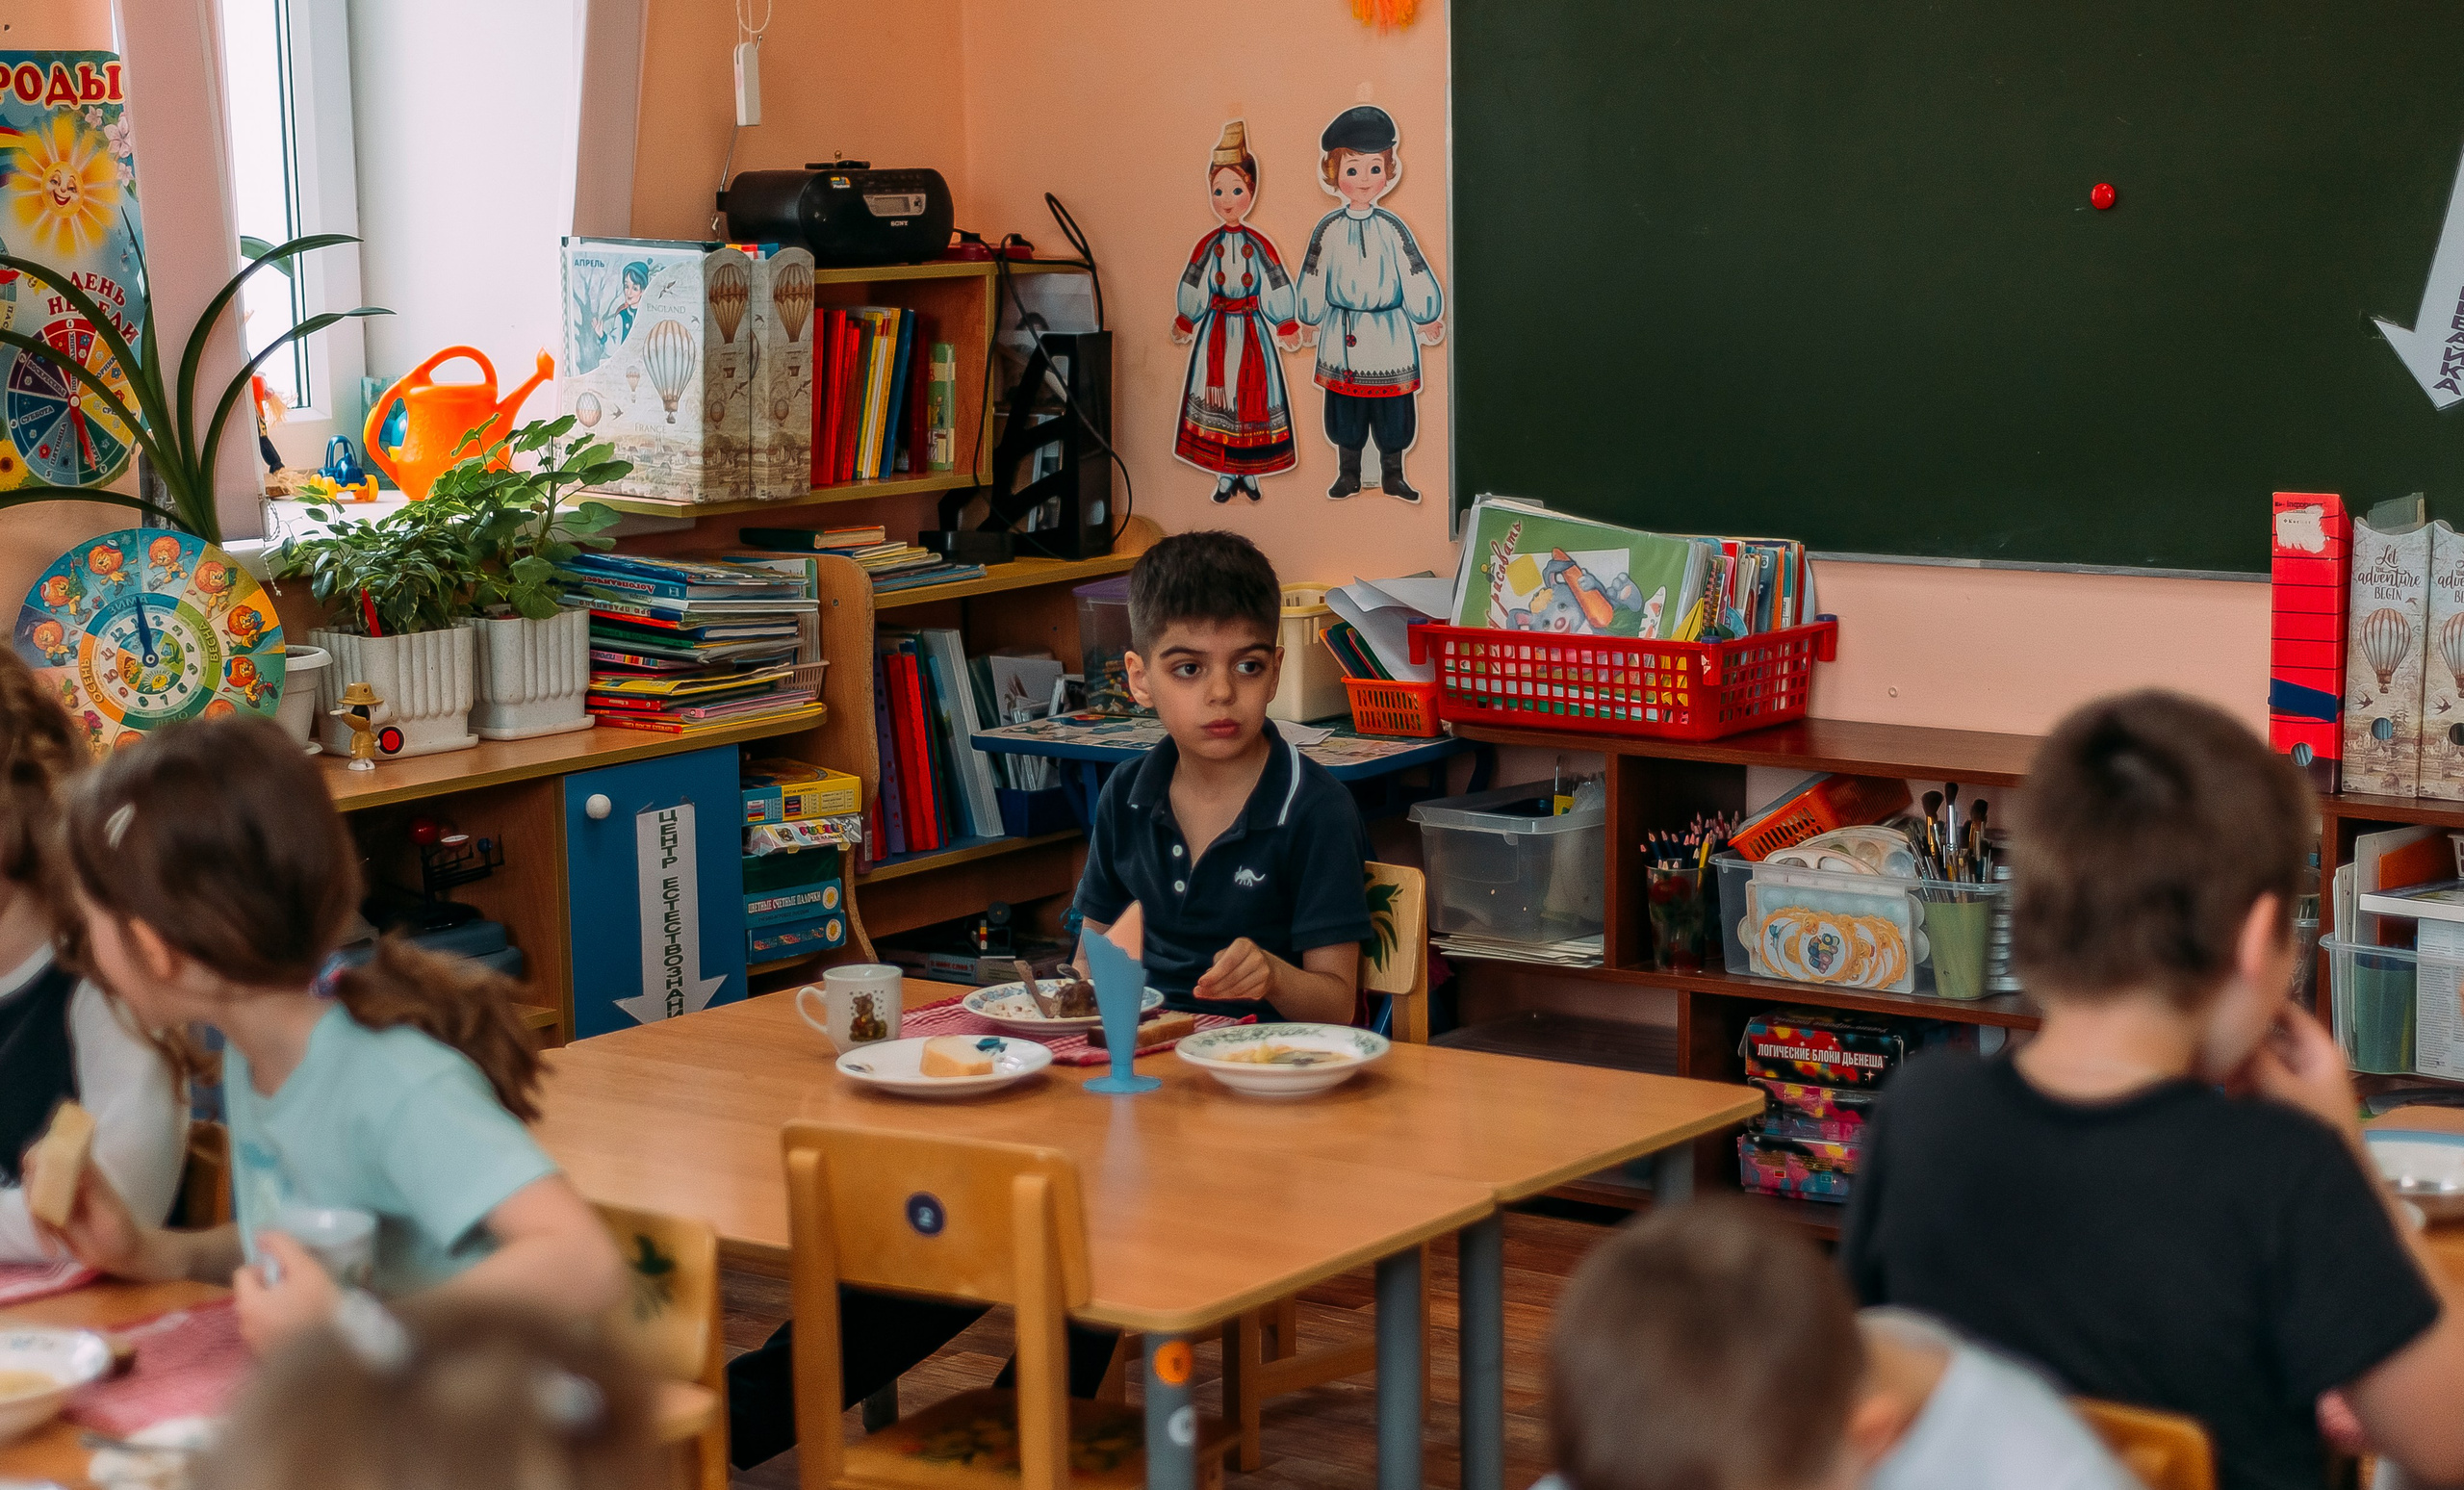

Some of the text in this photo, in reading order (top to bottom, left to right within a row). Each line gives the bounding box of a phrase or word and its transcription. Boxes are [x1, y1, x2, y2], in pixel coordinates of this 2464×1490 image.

[574, 258, 604, 268] АПРЕЛЬ
[647, 303, 686, 314] ENGLAND
[46, 295, 140, 346] НЕЕЛИ
[21, 407, 54, 424] СУББОТА
[635, 424, 666, 433] FRANCE
[50, 423, 67, 465] ПЯТНИЦА
[2375, 544, 2399, 569] Let
[2357, 566, 2421, 588] adventure
[108, 596, 148, 614] ЗИМА
[2374, 586, 2402, 601] BEGIN
[198, 621, 220, 662] ВЕСНА
[80, 659, 104, 703] ОСЕНЬ
[659, 809, 678, 869] ЦЕНТР
[1758, 1043, 1884, 1068] ЛОГИЧЕСКИЕ БЛОКИ ДЬЕНЕША
